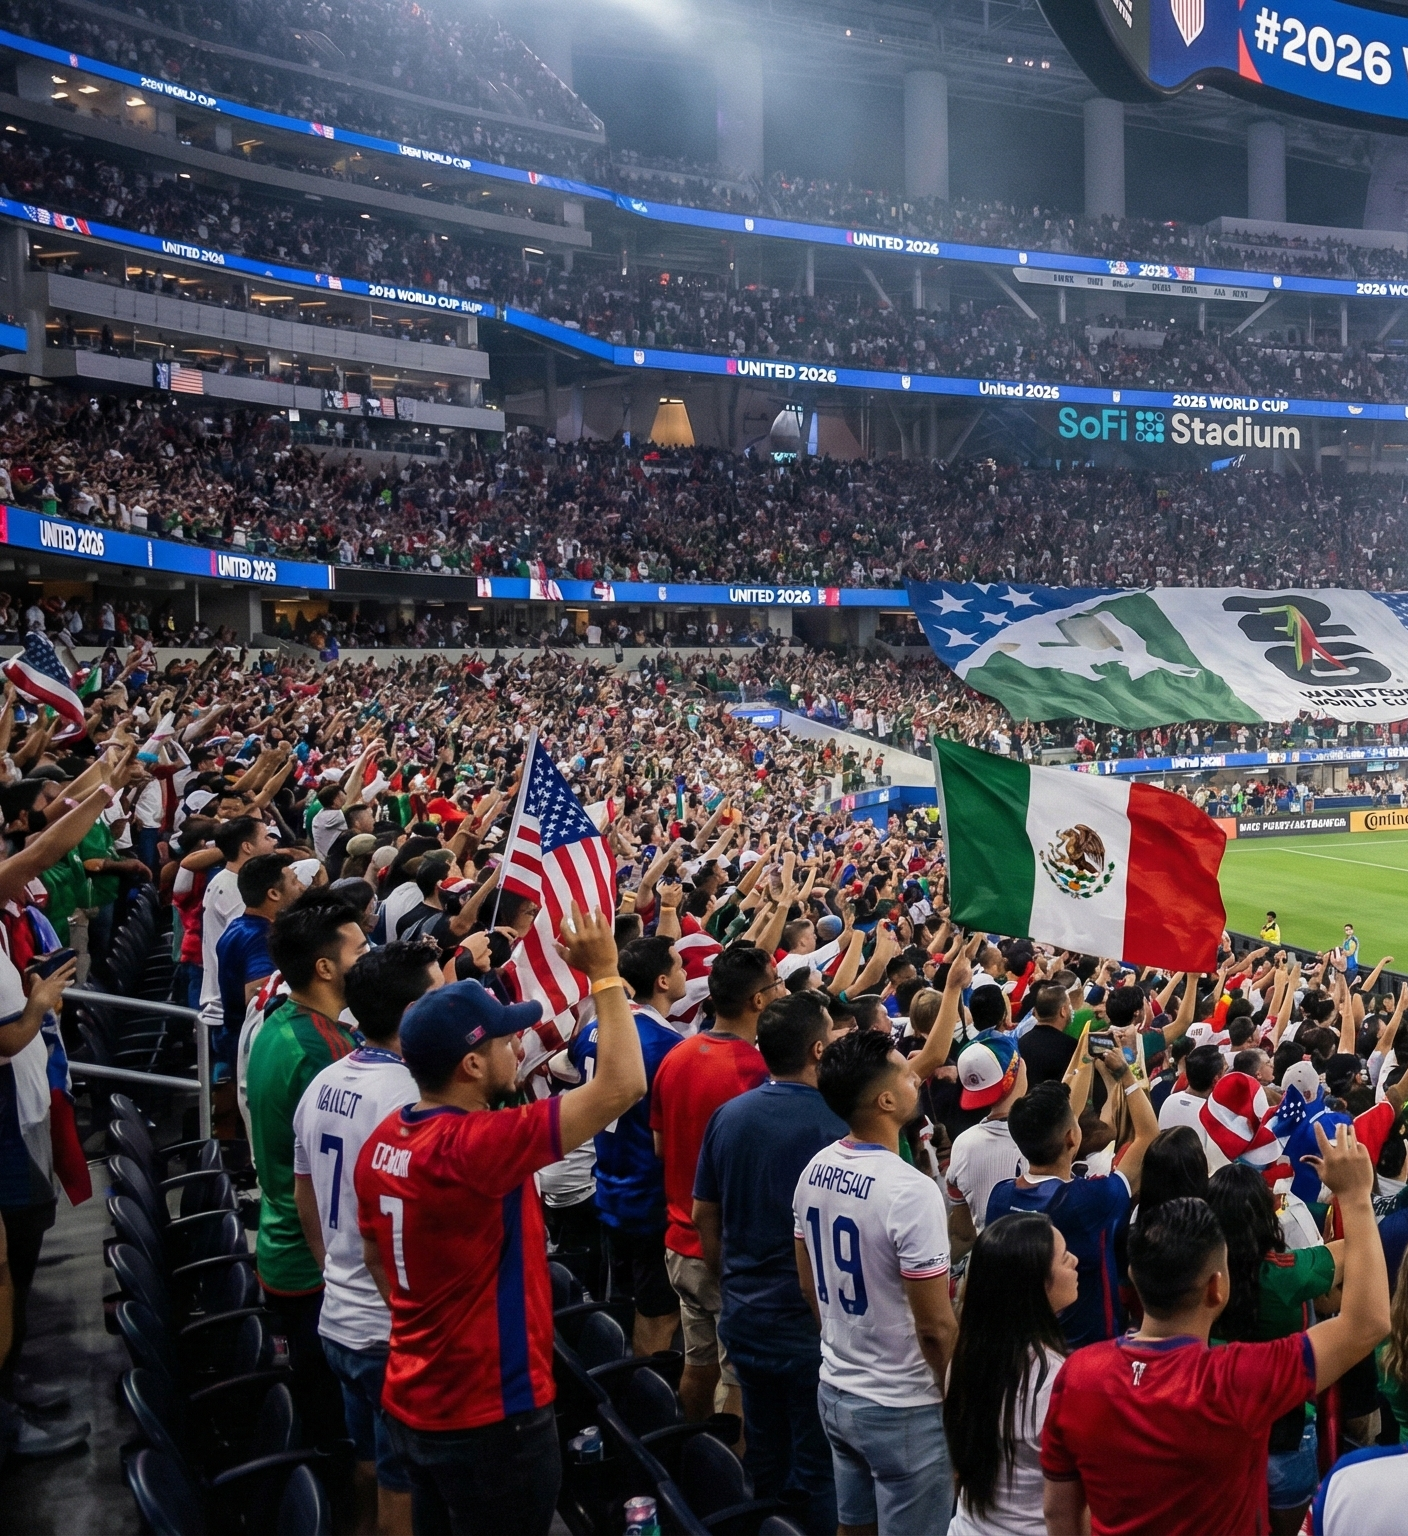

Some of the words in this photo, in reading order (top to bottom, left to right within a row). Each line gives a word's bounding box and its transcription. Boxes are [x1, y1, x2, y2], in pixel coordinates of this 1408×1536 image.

[1255, 7, 1392, 85] #2026
[853, 232, 904, 251] UNITED
[905, 240, 940, 255] 2026
[396, 288, 437, 306] WORLD
[437, 297, 460, 311] CUP
[1356, 282, 1388, 296] 2026
[737, 360, 796, 380] UNITED
[798, 366, 838, 384] 2026
[1025, 384, 1061, 400] 2026
[1172, 394, 1208, 409] 2026
[1208, 396, 1260, 411] WORLD
[1261, 400, 1290, 413] CUP
[1058, 407, 1128, 442] SoFi
[1171, 413, 1301, 450] Stadium
[729, 588, 775, 604] UNITED
[776, 589, 811, 604] 2026
[319, 1132, 344, 1230] 7
[806, 1206, 868, 1316] 19
